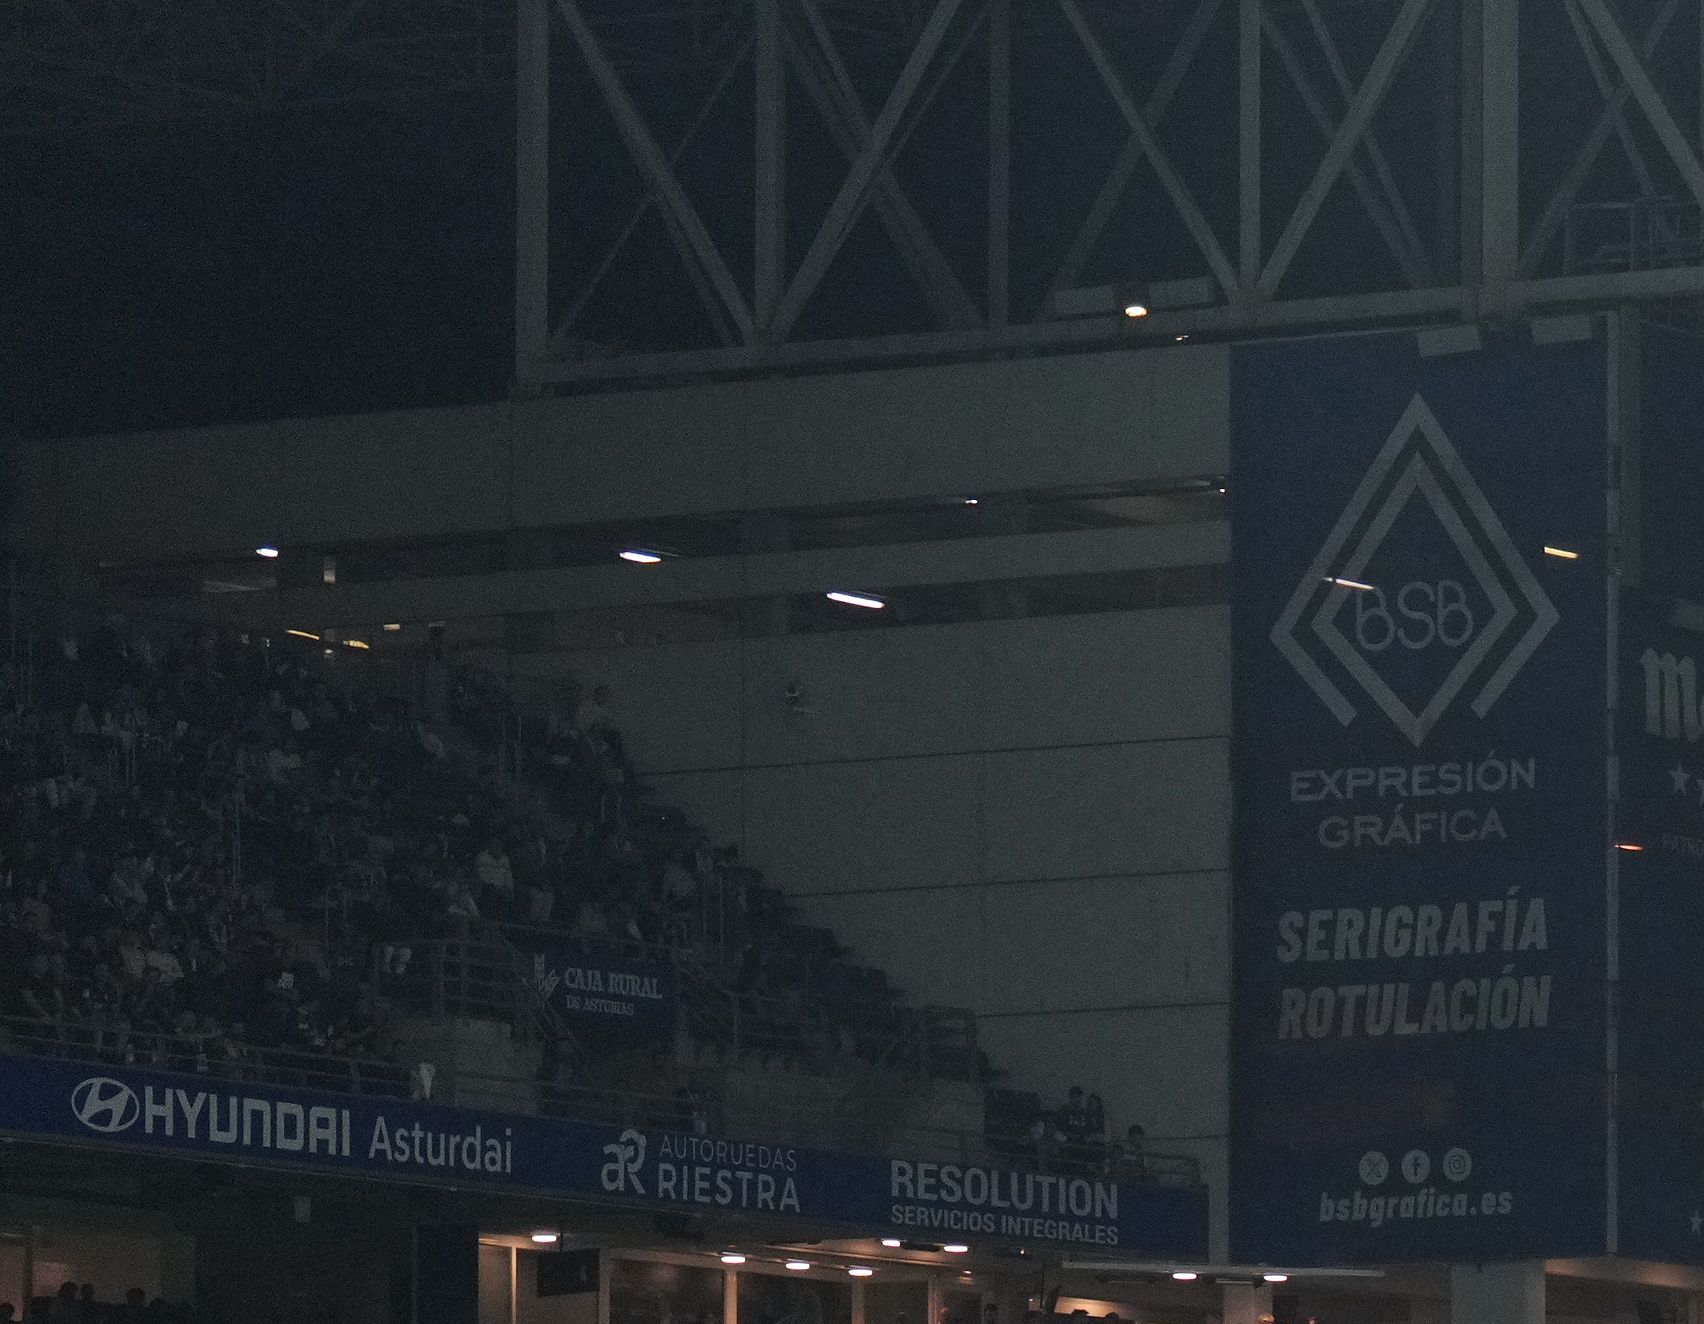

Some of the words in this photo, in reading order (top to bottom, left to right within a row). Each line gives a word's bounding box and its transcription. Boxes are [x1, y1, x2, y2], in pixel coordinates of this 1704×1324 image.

[1290, 750, 1535, 802] EXPRESIÓN
[1317, 803, 1506, 849] GRÁFICA
[1276, 886, 1548, 963] SERIGRAFÍA
[564, 966, 605, 992] CAJA
[607, 972, 663, 999] RURAL
[1278, 965, 1551, 1039] ROTULACIÓN
[144, 1086, 351, 1157] HYUNDAI
[368, 1115, 513, 1175] Asturdai
[659, 1134, 797, 1172] AUTORUEDAS
[658, 1162, 801, 1214] RIESTRA
[891, 1160, 1119, 1220] RESOLUTION
[1319, 1190, 1513, 1228] bsbgrafica.es
[891, 1204, 995, 1234] SERVICIOS
[1000, 1216, 1119, 1246] INTEGRALES
